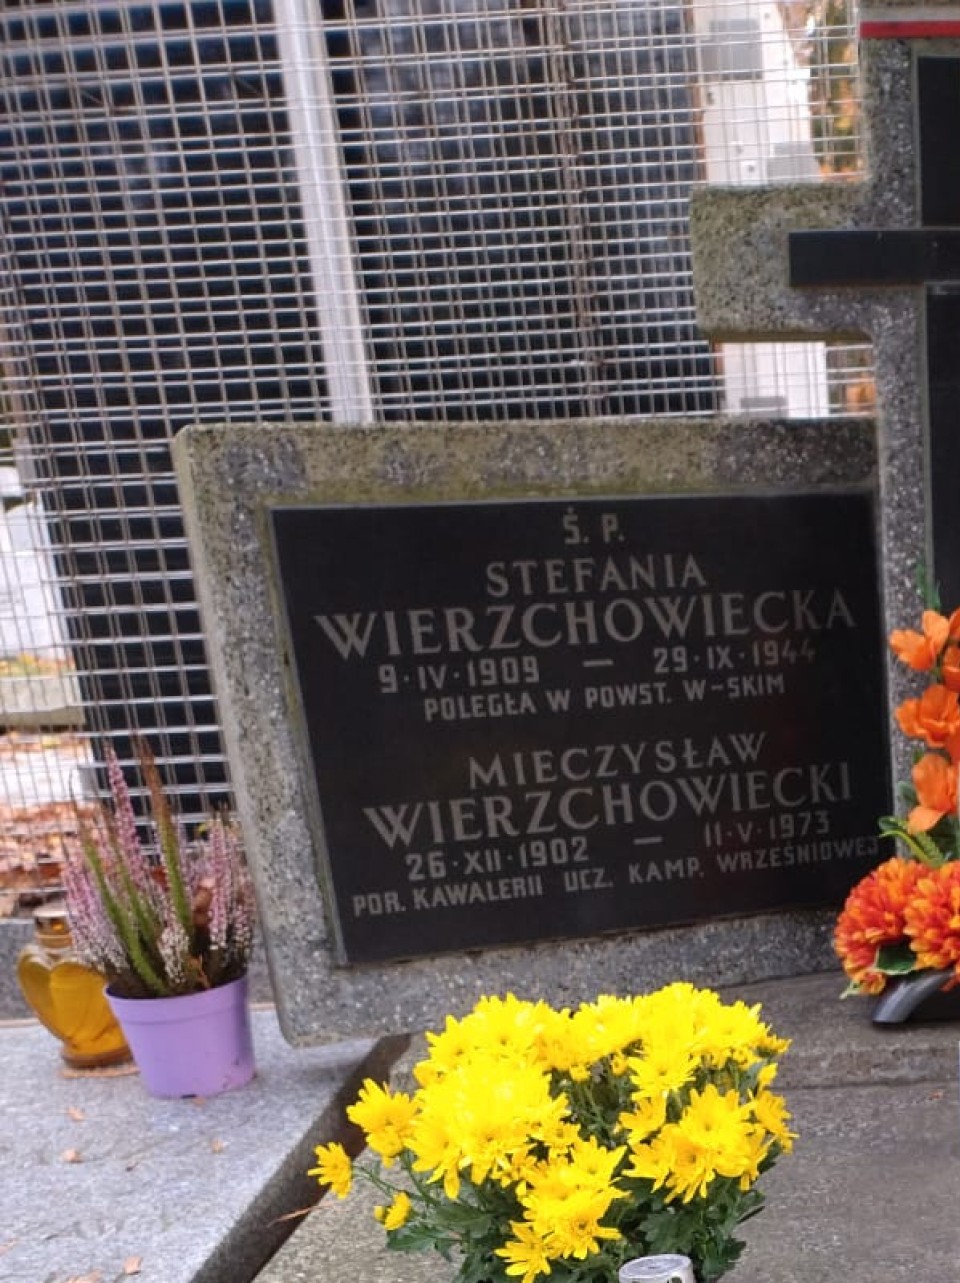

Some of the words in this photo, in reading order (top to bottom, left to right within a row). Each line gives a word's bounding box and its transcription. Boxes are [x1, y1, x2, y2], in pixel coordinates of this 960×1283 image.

[602, 513, 625, 542] P.
[486, 553, 707, 598] STEFANIA
[315, 588, 857, 660] WIERZCHOWIECKA
[424, 694, 536, 722] POLEGŁA
[546, 689, 571, 711] W
[584, 683, 672, 709] POWST.
[467, 732, 767, 790] MIECZYSŁAW
[362, 762, 852, 850] WIERZCHOWIECKI
[353, 894, 406, 920] POR.
[413, 875, 543, 911] KAWALERII
[564, 868, 613, 893] UCZ.
[629, 857, 704, 884] KAMP.
